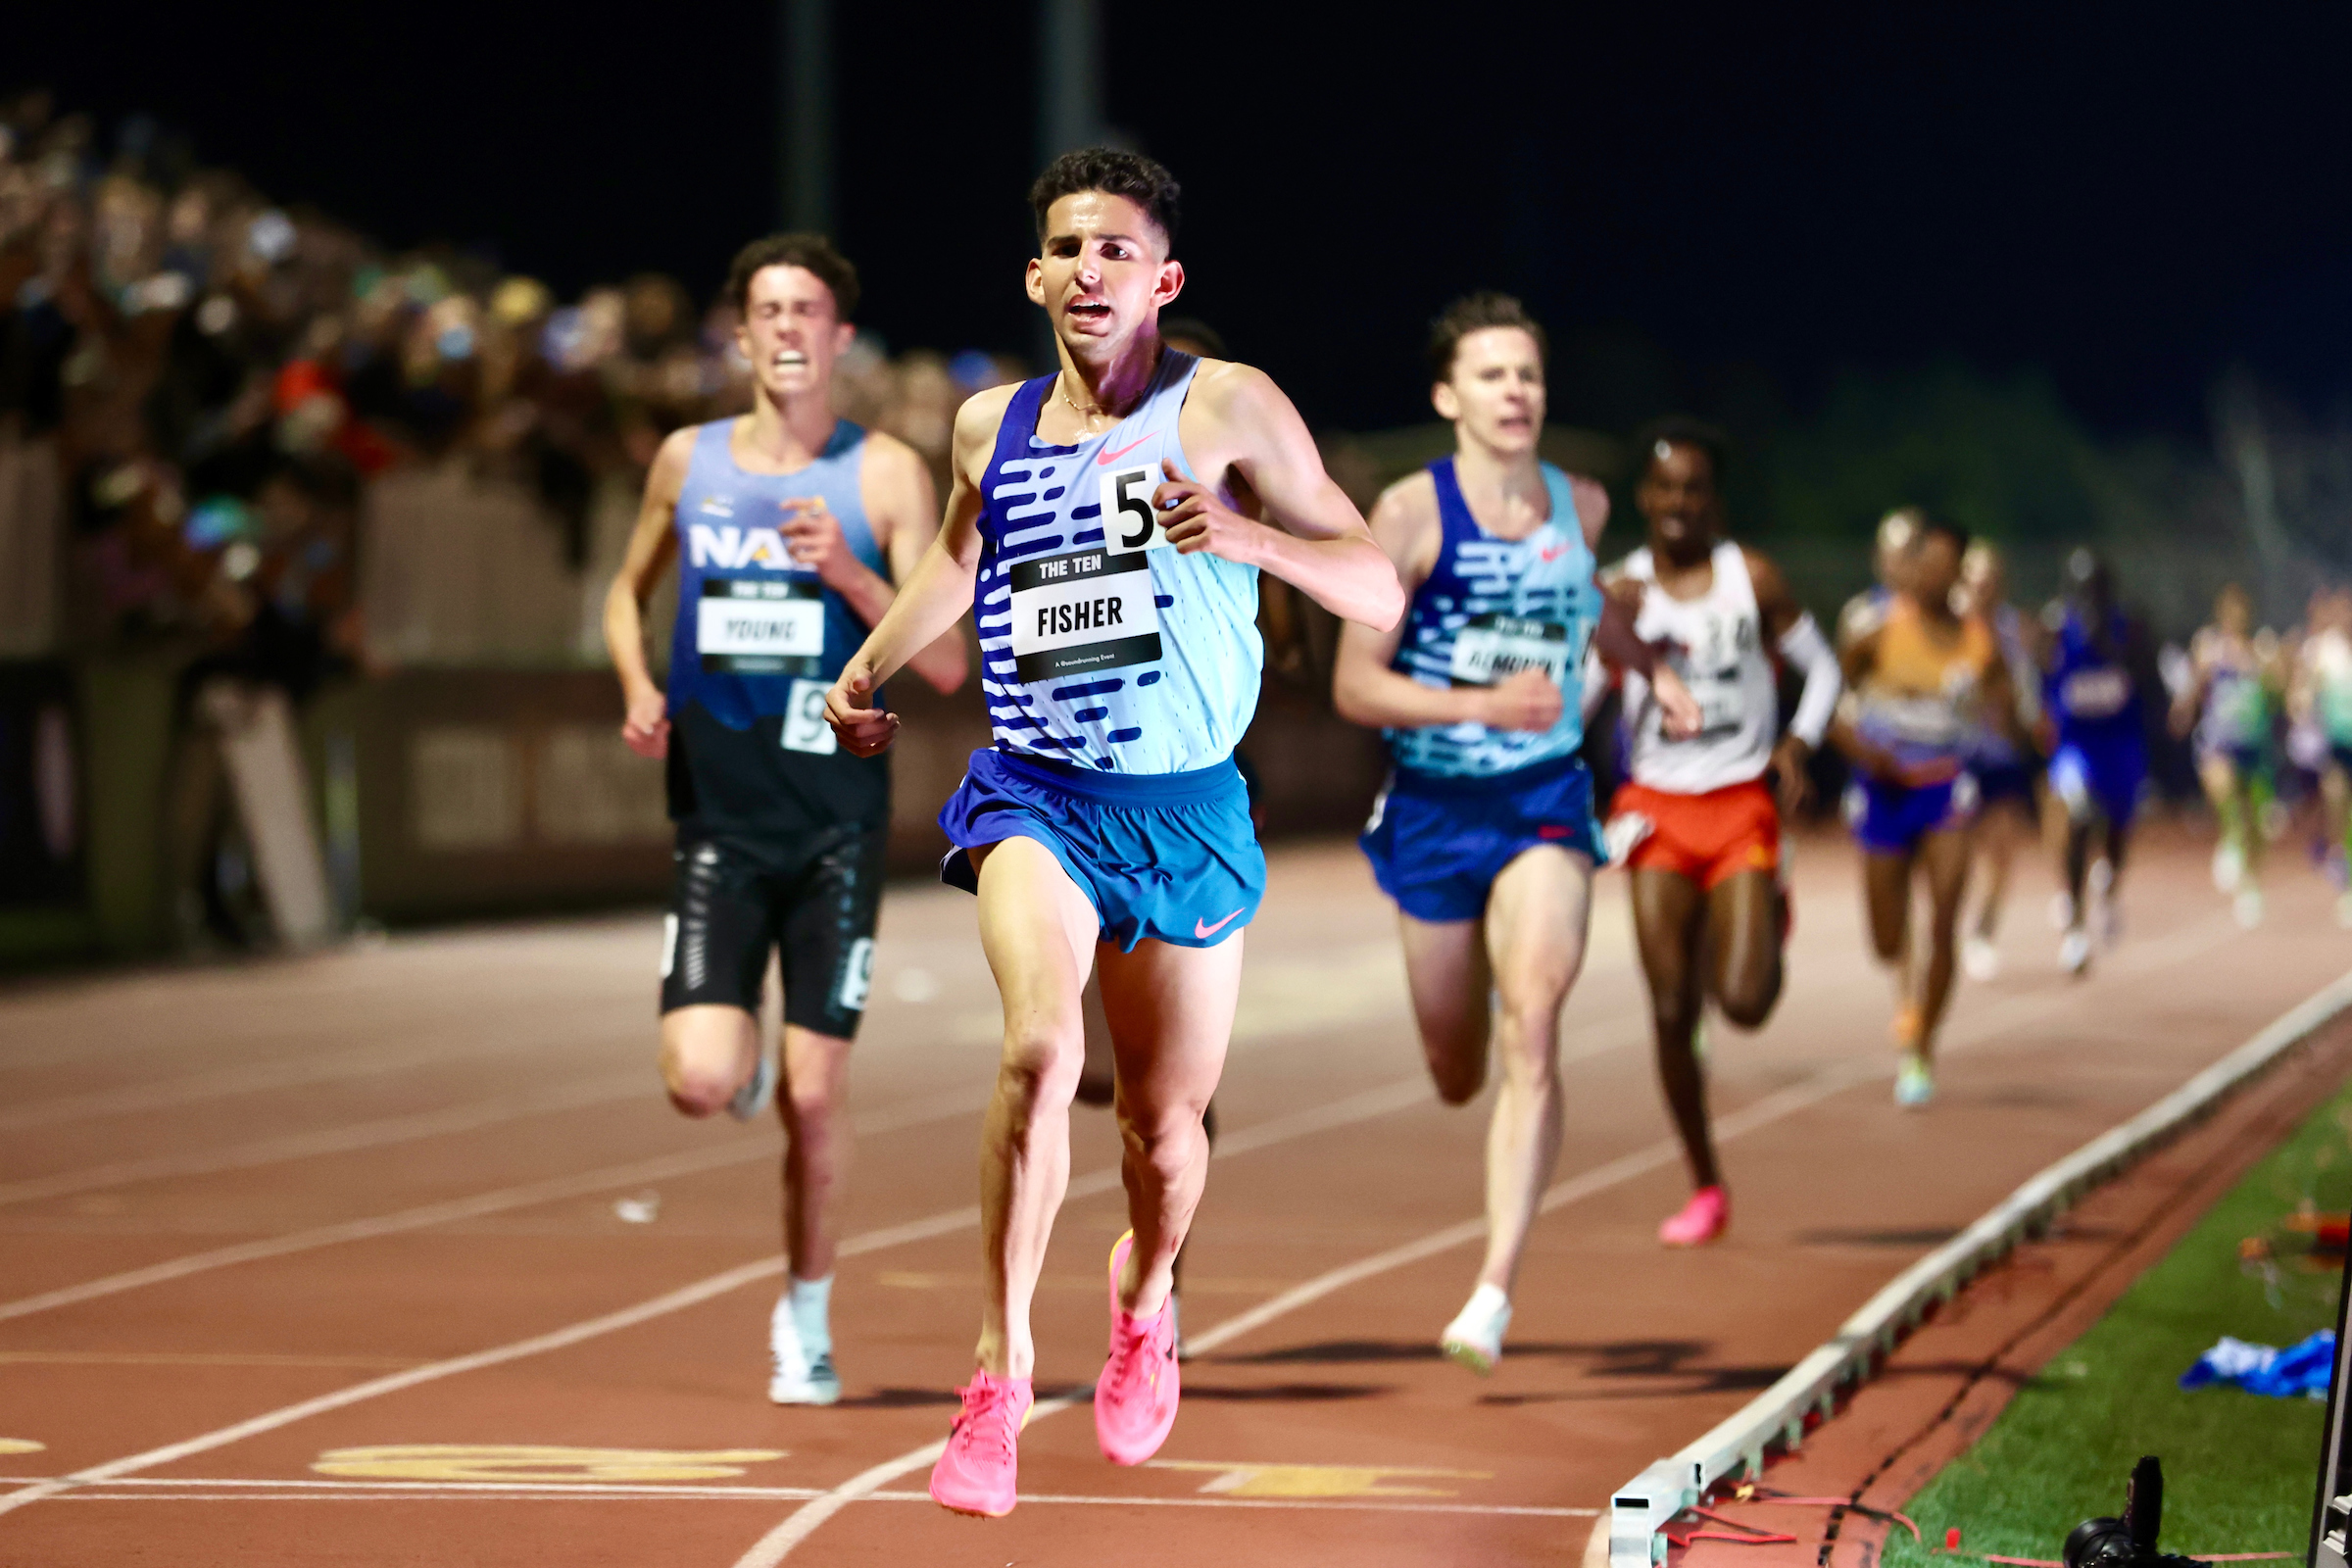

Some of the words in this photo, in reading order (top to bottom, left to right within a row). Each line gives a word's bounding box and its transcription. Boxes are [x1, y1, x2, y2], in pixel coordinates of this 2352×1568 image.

[1115, 470, 1154, 548] 5
[689, 522, 817, 571] NA
[1039, 560, 1068, 579] THE
[1072, 554, 1102, 573] TEN
[1038, 597, 1123, 637] FISHER
[1101, 653, 1115, 662] Event
[802, 688, 827, 743] 9
